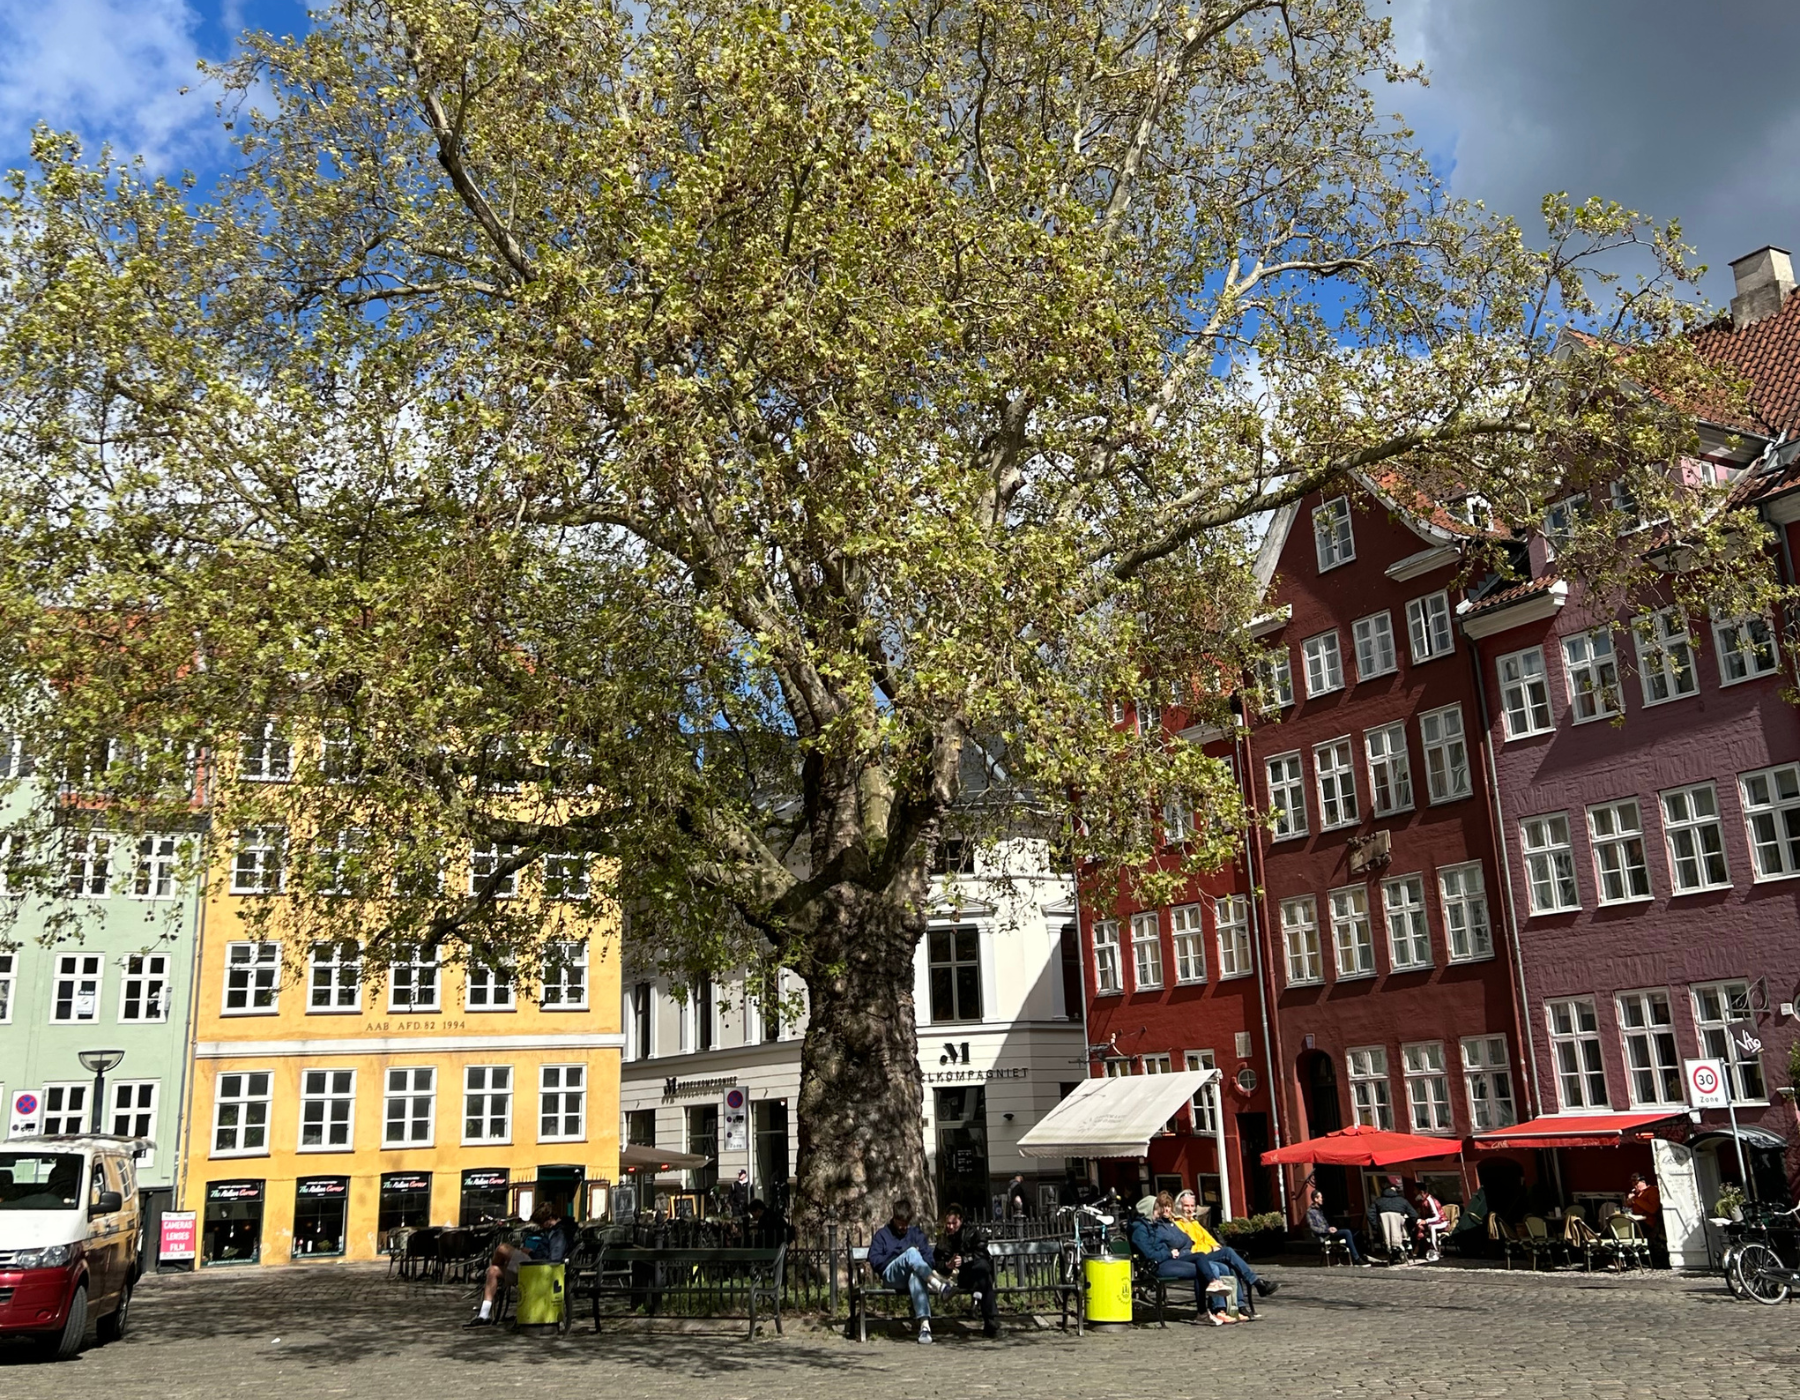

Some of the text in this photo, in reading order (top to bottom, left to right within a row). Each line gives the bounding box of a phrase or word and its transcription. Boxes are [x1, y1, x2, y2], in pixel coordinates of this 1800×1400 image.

[365, 1022, 390, 1031] AAB
[442, 1021, 466, 1030] 1994
[1697, 1073, 1714, 1086] 30
[163, 1220, 193, 1230] CAMERAS
[170, 1243, 186, 1251] FILM
